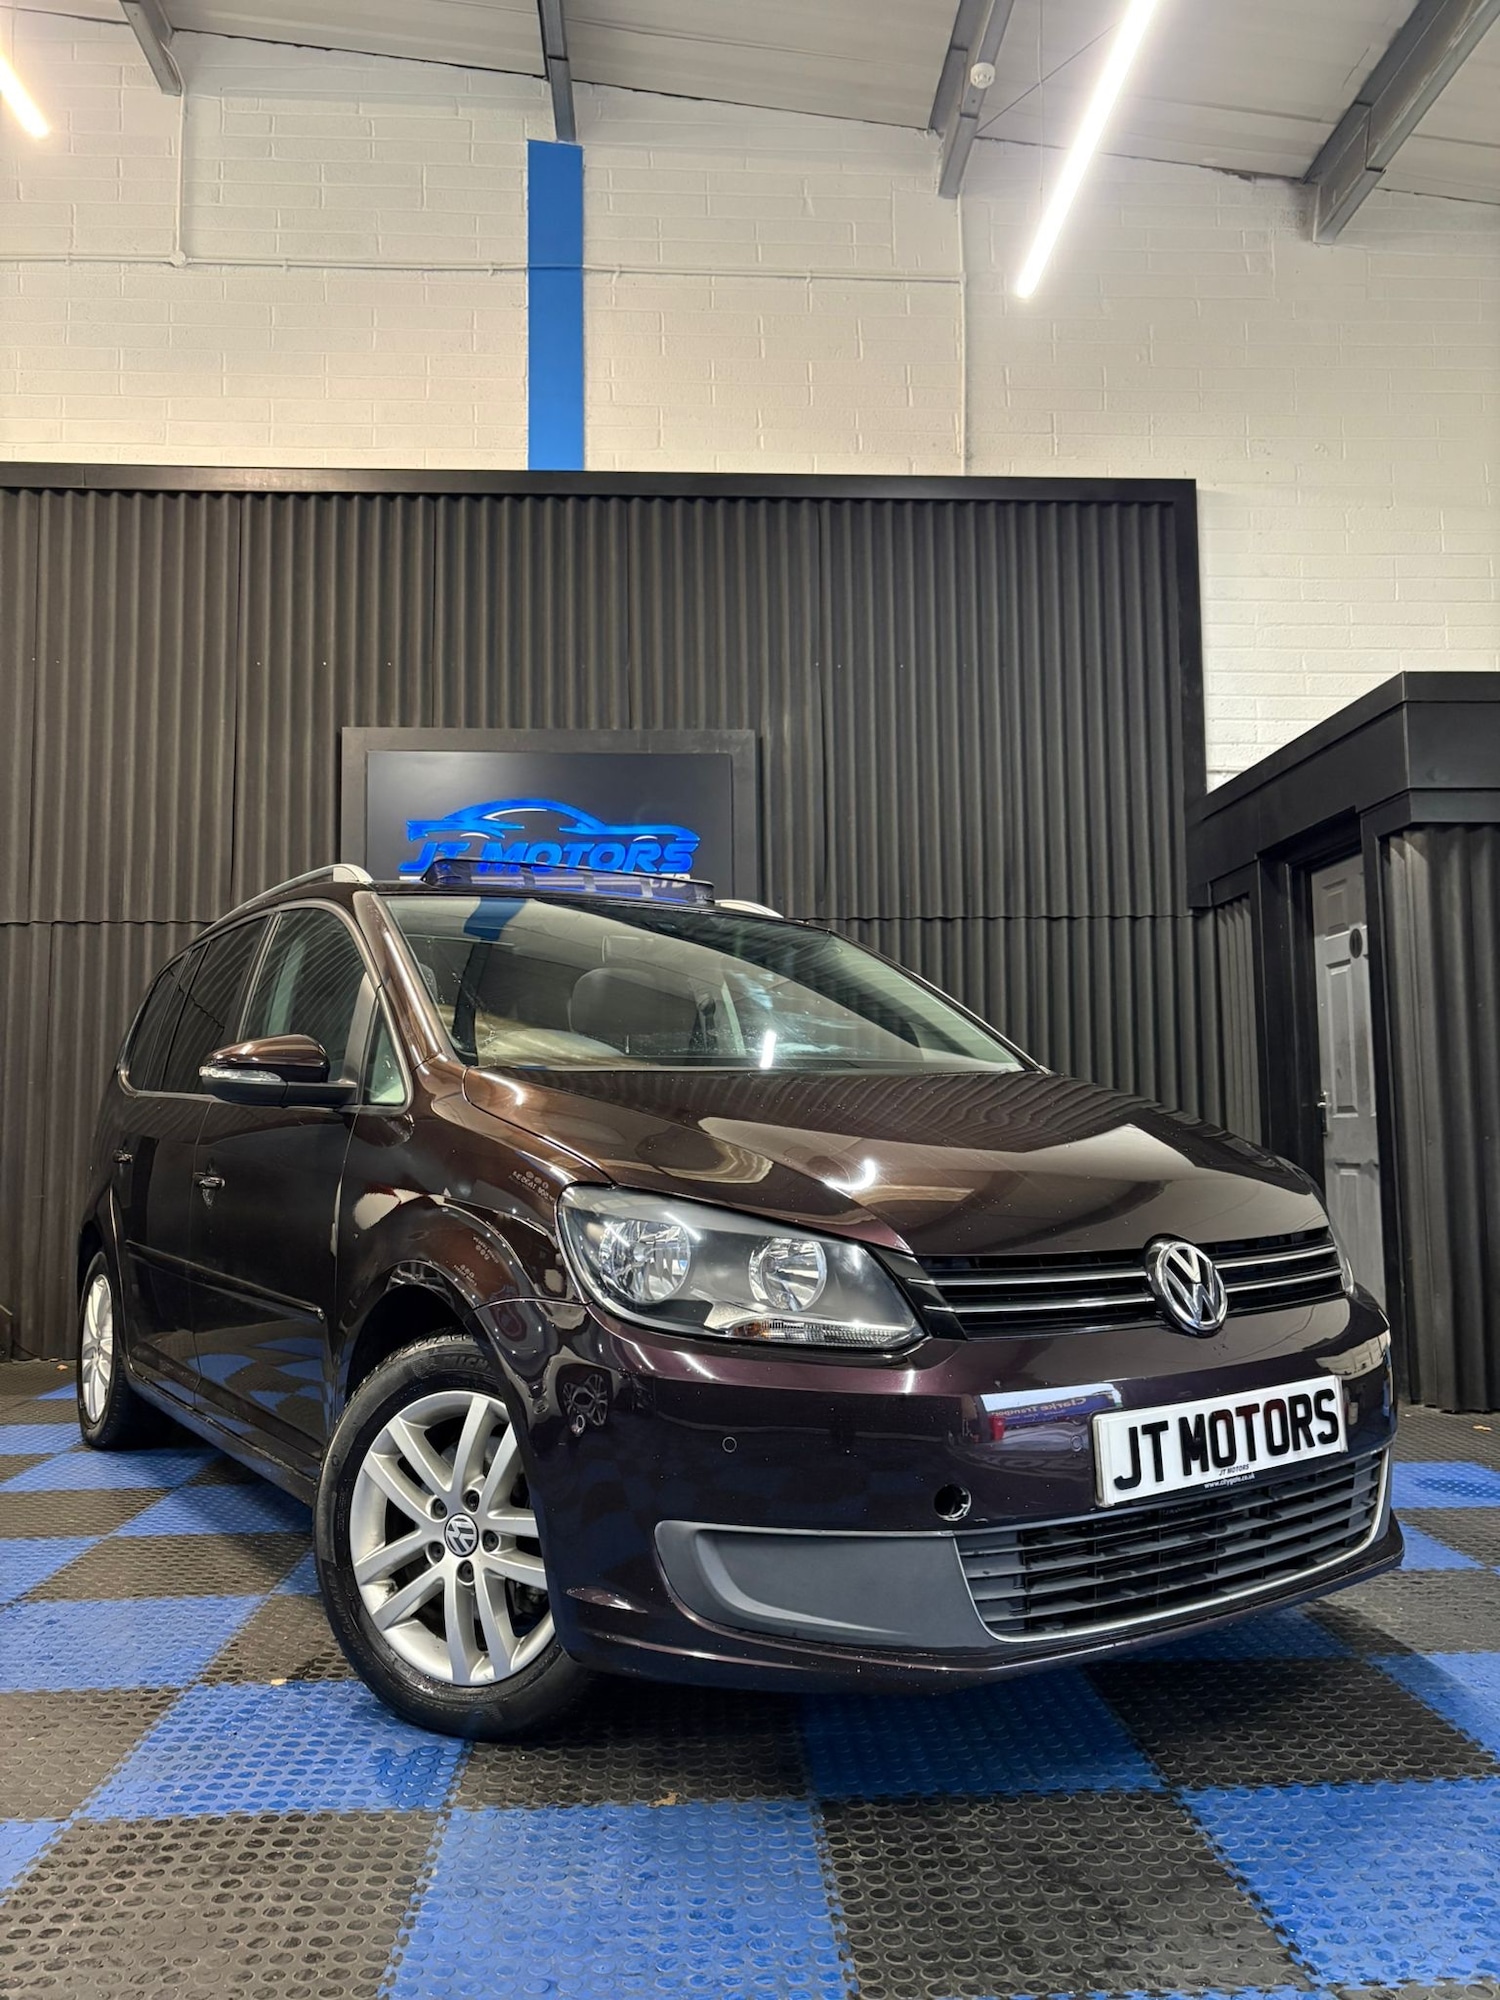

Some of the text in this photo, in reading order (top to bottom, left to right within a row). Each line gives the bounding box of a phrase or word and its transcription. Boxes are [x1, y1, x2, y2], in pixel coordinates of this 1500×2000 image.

[398, 842, 699, 873] JT MOTORS
[1114, 1388, 1340, 1490] JT MOTORS
[1227, 1464, 1250, 1474] MOTORS
